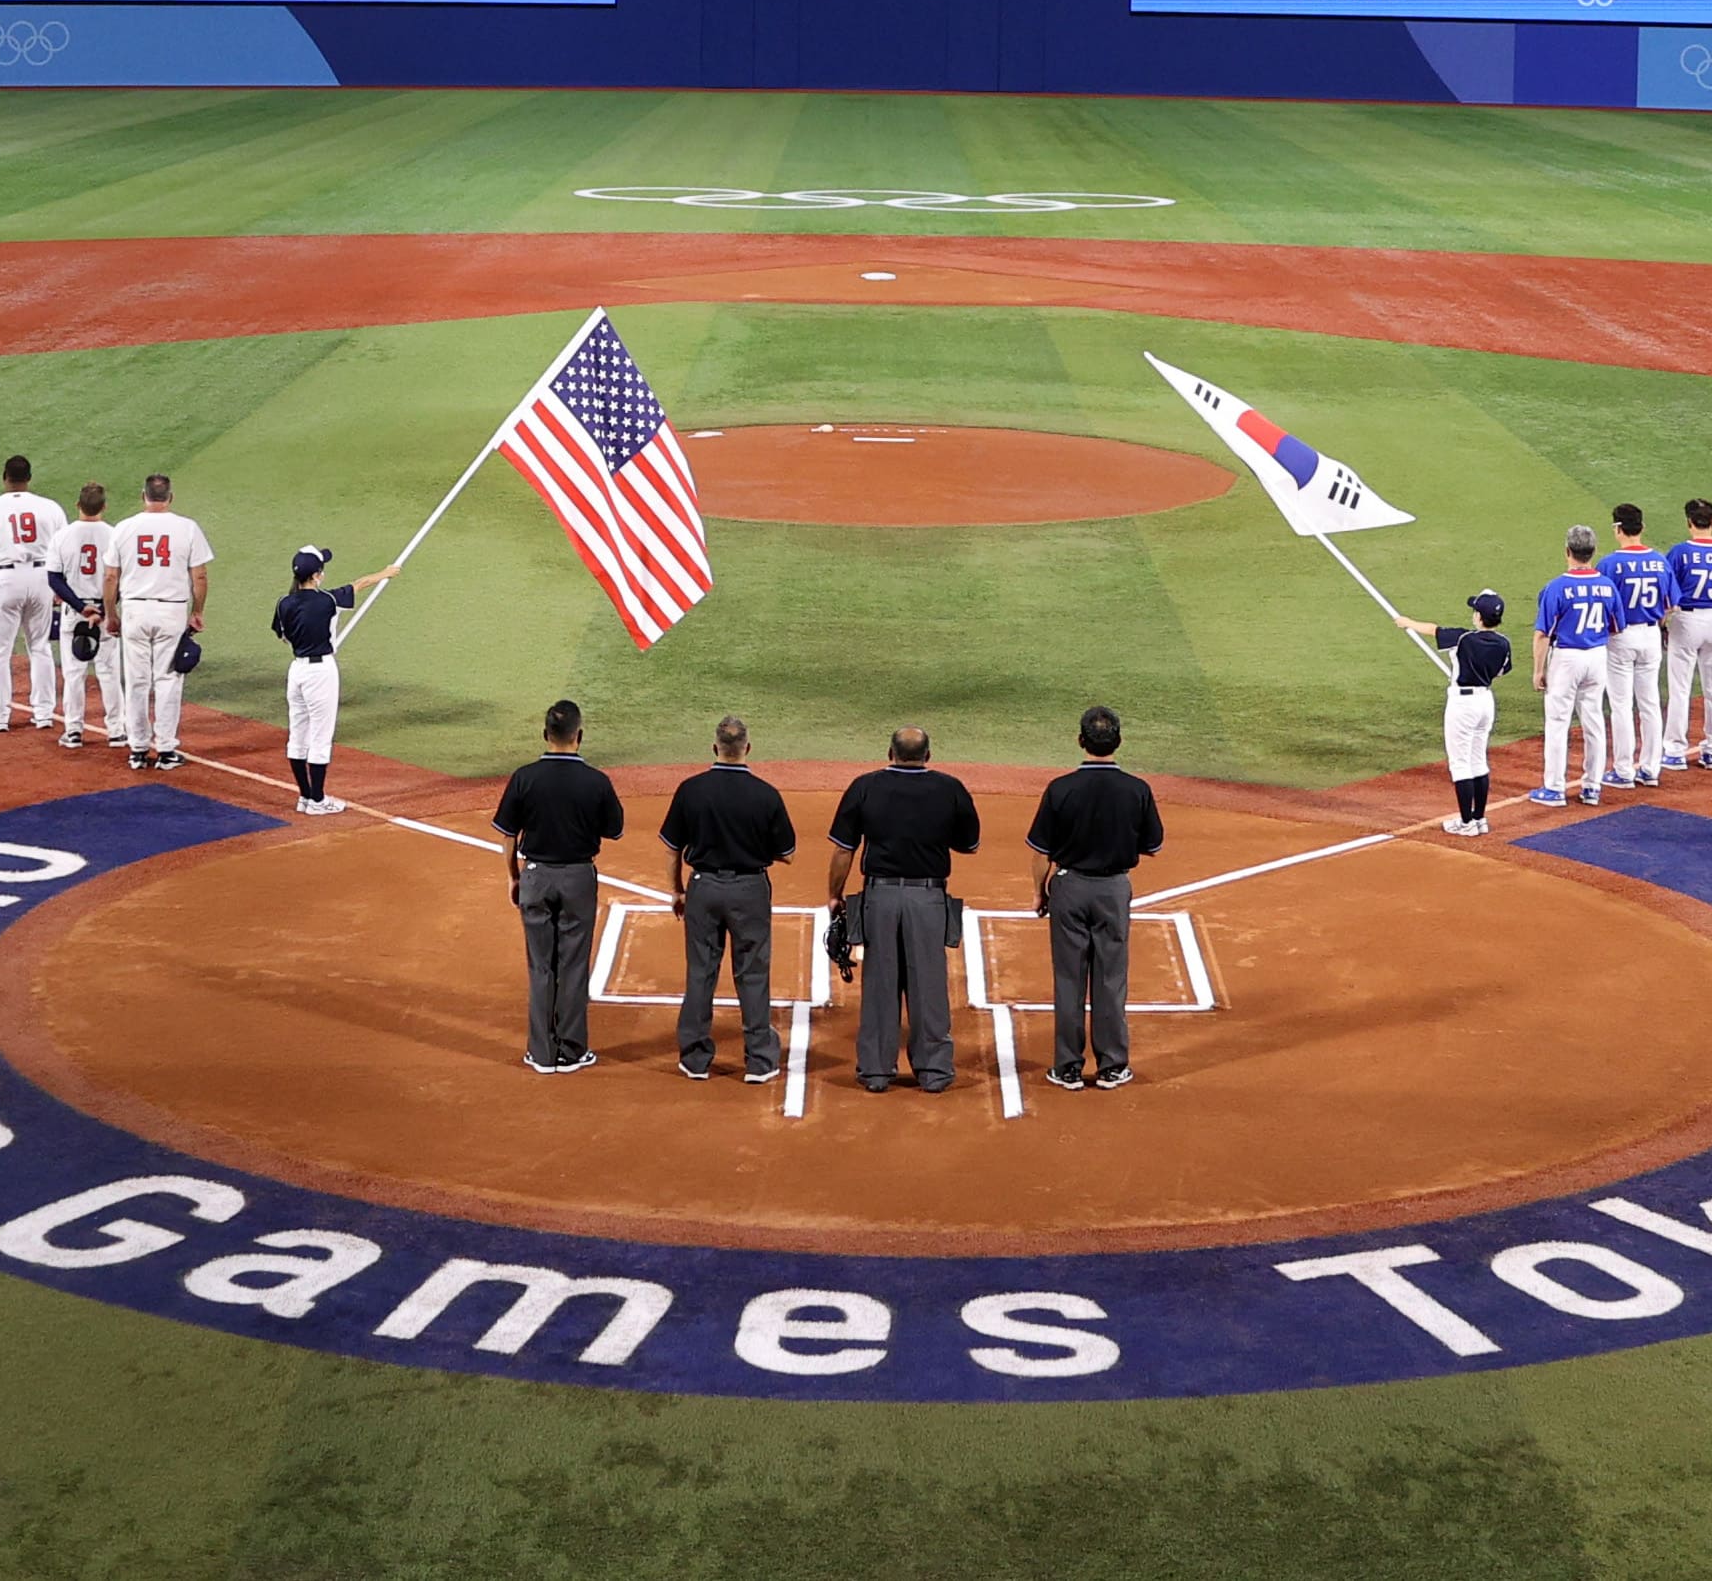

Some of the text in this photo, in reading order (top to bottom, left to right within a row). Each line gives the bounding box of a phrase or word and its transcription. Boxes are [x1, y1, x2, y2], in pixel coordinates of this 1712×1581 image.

[8, 512, 37, 544] 19
[80, 544, 97, 575] 3
[137, 535, 171, 567] 54
[1692, 553, 1700, 563] E
[1616, 561, 1664, 573] J Y LEE
[1564, 585, 1612, 599] K M KIM
[1625, 577, 1658, 609] 75
[1572, 601, 1604, 635] 74
